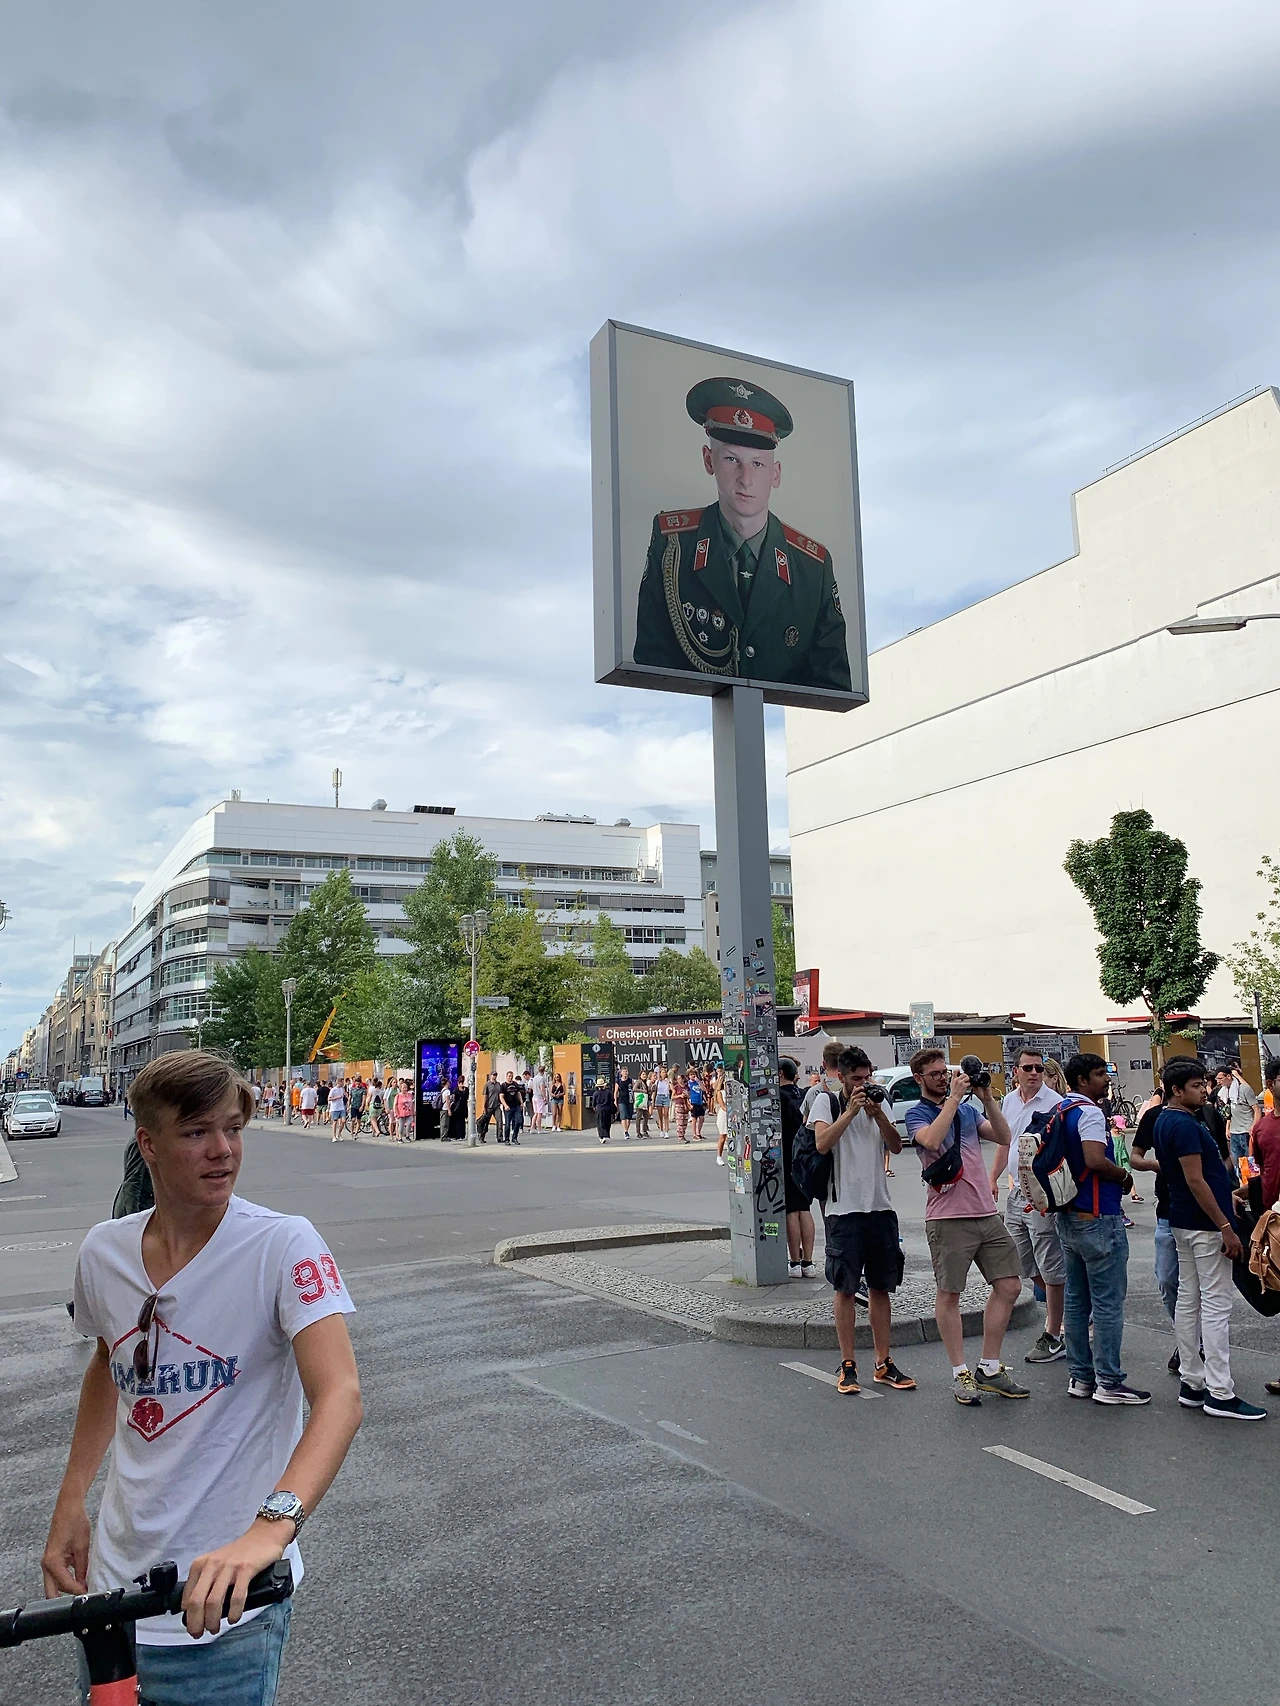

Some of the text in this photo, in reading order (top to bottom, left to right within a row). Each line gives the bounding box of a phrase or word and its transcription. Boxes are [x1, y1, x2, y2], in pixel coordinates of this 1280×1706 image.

[606, 1025, 724, 1040] Checkpoint Charlie Bla
